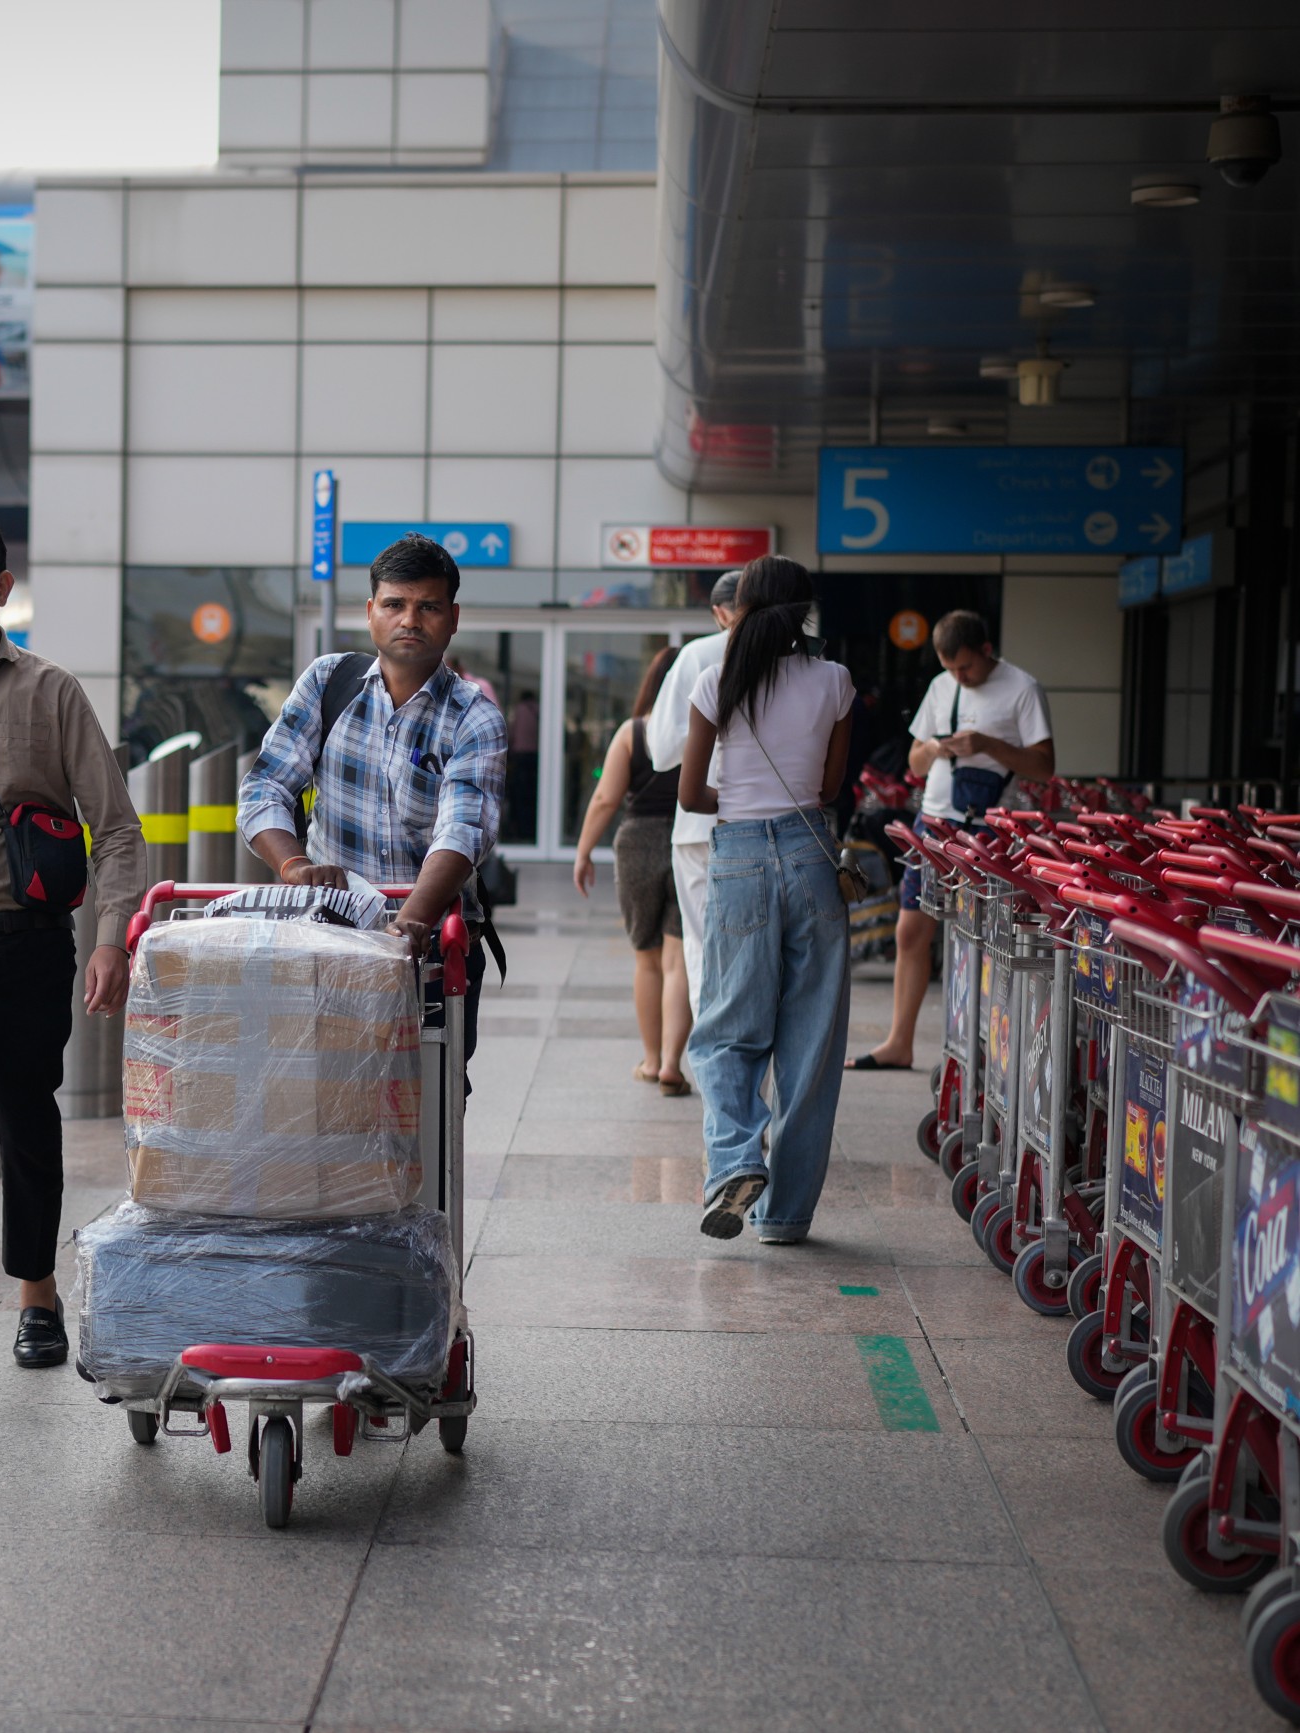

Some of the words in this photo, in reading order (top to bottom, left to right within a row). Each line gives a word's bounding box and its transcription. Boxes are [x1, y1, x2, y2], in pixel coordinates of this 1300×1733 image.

[841, 468, 891, 549] 5
[652, 546, 673, 560] No
[972, 530, 1075, 547] Departures
[1027, 1014, 1049, 1084] ENERGY
[1180, 1088, 1229, 1146] MILAN
[1191, 1146, 1203, 1165] NEW
[1203, 1153, 1217, 1172] YORK
[1243, 1205, 1288, 1306] Cola
